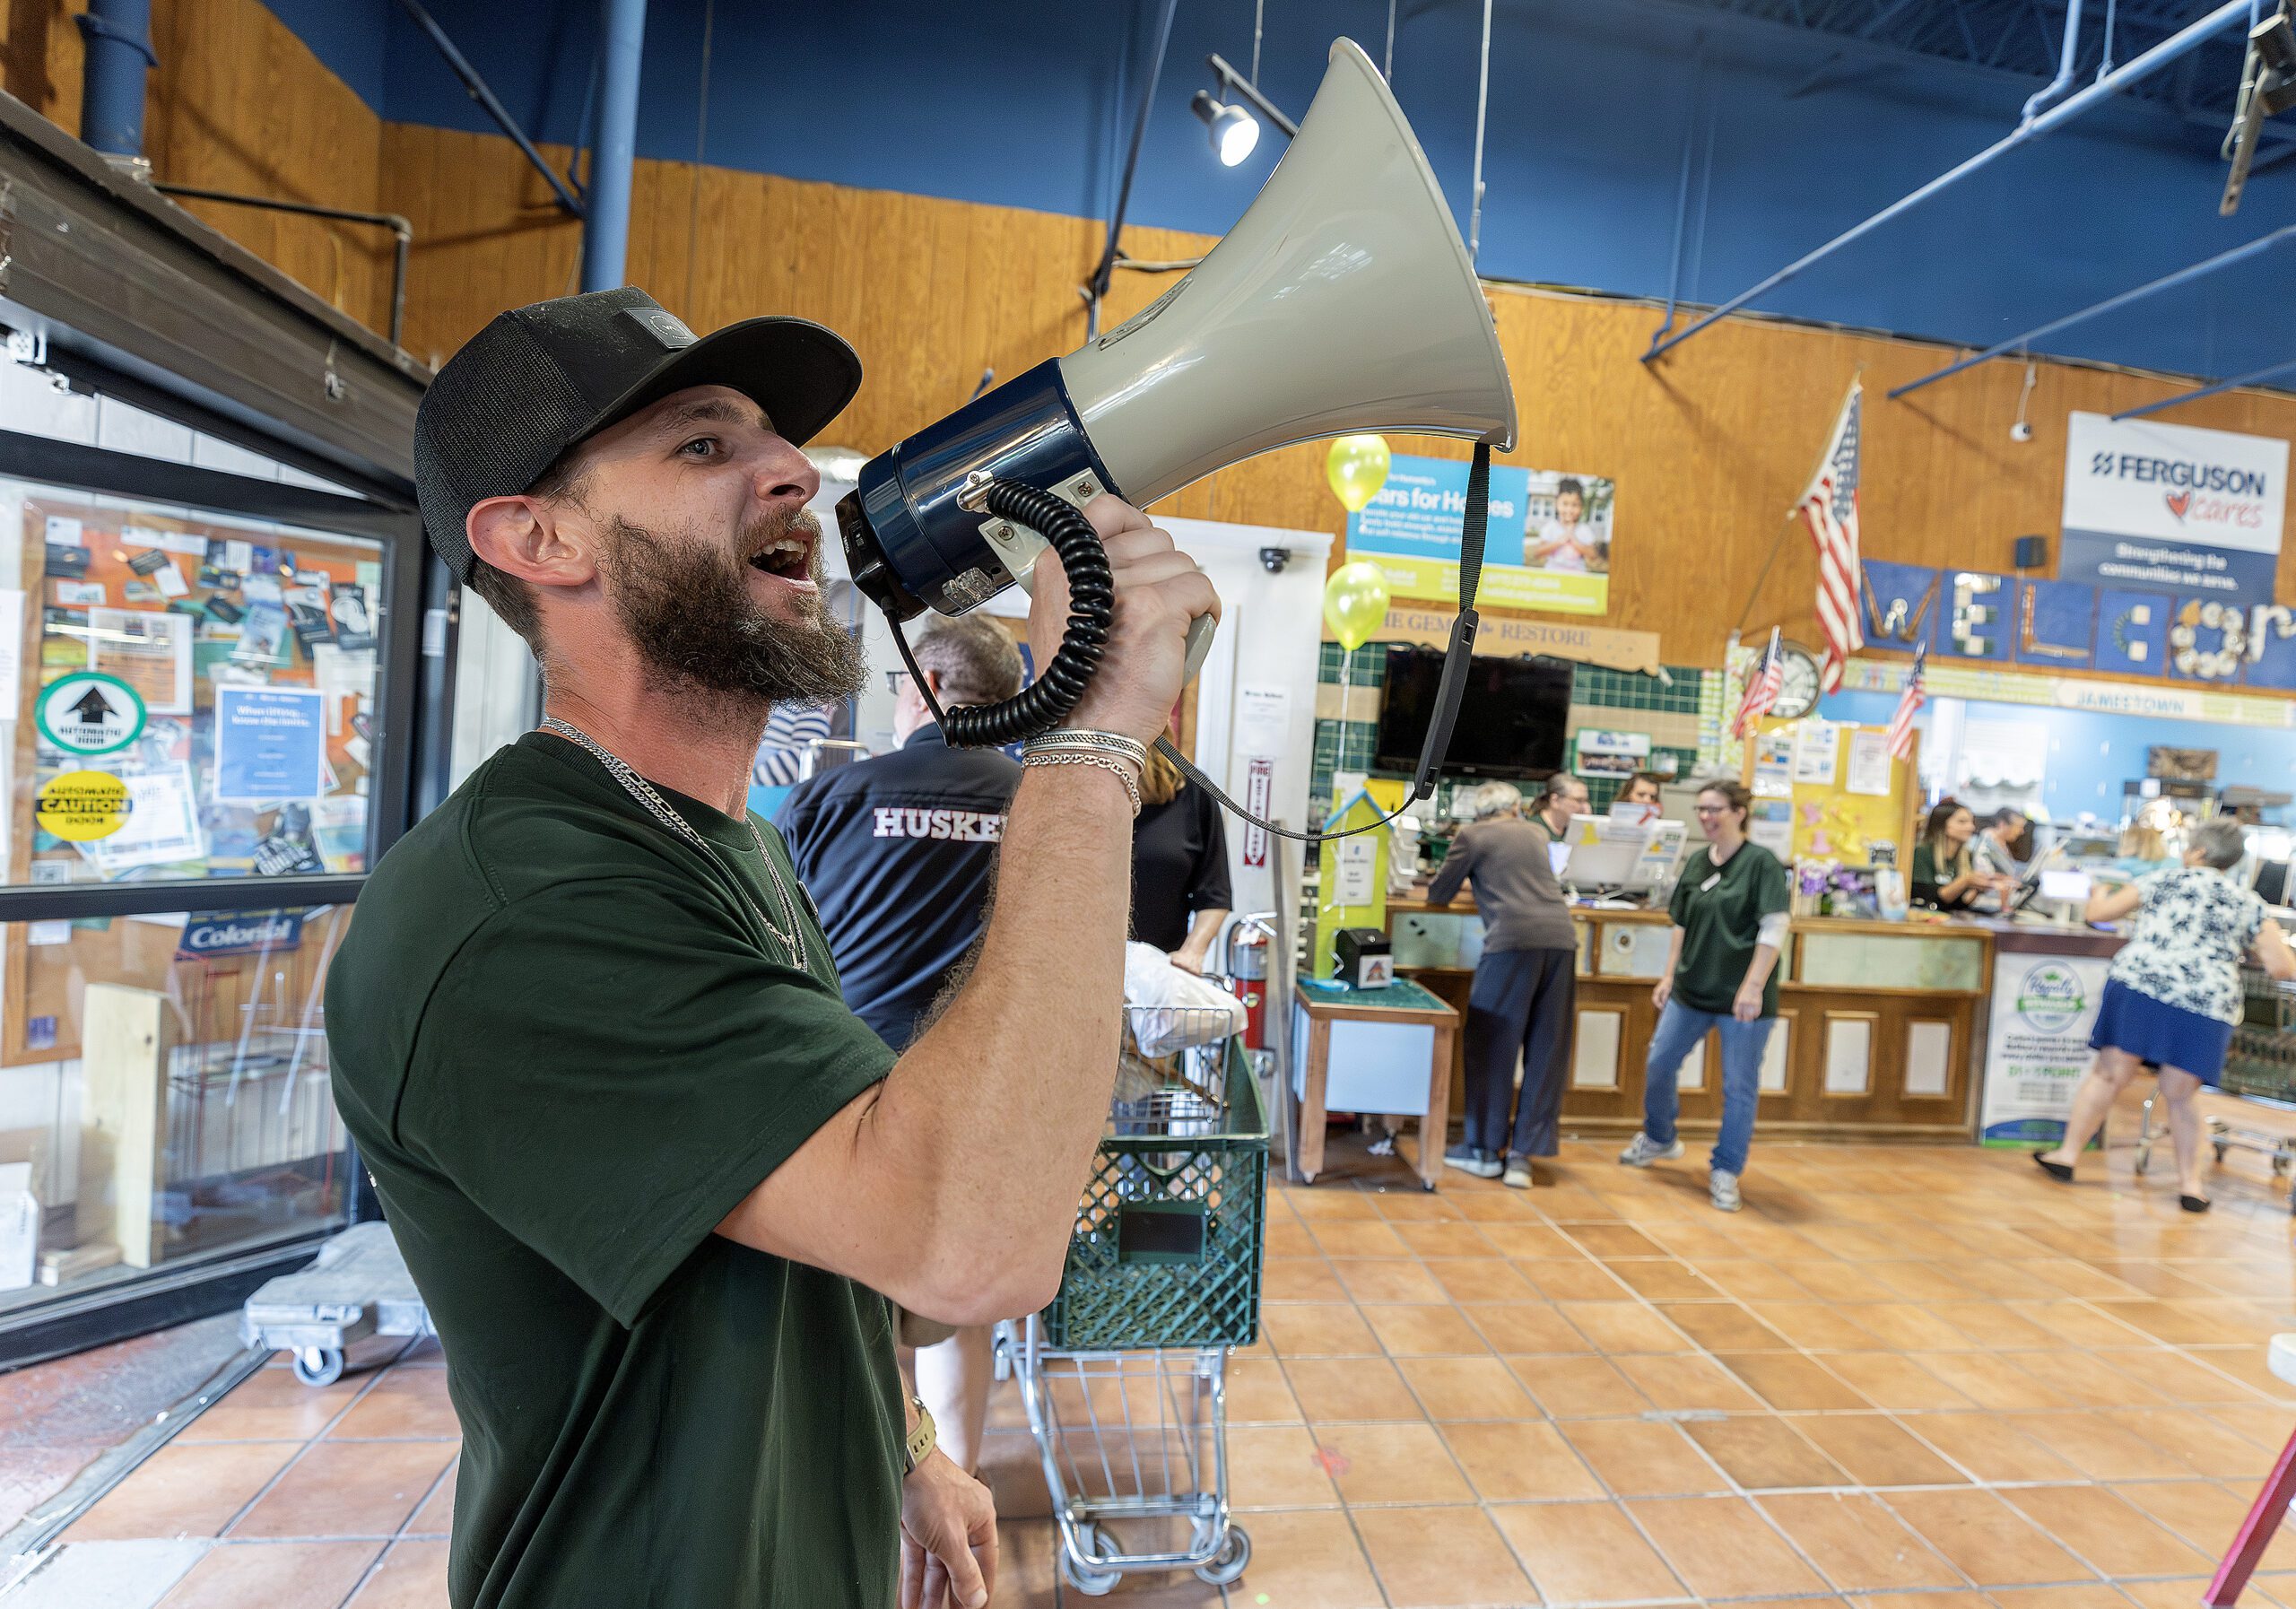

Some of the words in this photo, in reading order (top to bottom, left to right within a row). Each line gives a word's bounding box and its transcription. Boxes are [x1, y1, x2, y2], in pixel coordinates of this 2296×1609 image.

[2118, 456, 2266, 496] FERGUSON
[1369, 487, 1410, 509] ars
[1411, 487, 1441, 509] for
[1441, 490, 1515, 518] Hoes
[2192, 497, 2264, 528] cares
[2116, 542, 2205, 570] Strengthening
[2098, 561, 2182, 584] communities
[1500, 622, 1592, 648] RESTORE
[2075, 691, 2186, 714] JAMESTOWN
[1250, 765, 1270, 777] FIRE
[41, 799, 129, 813] CAUTION
[189, 918, 293, 948] Colonial
